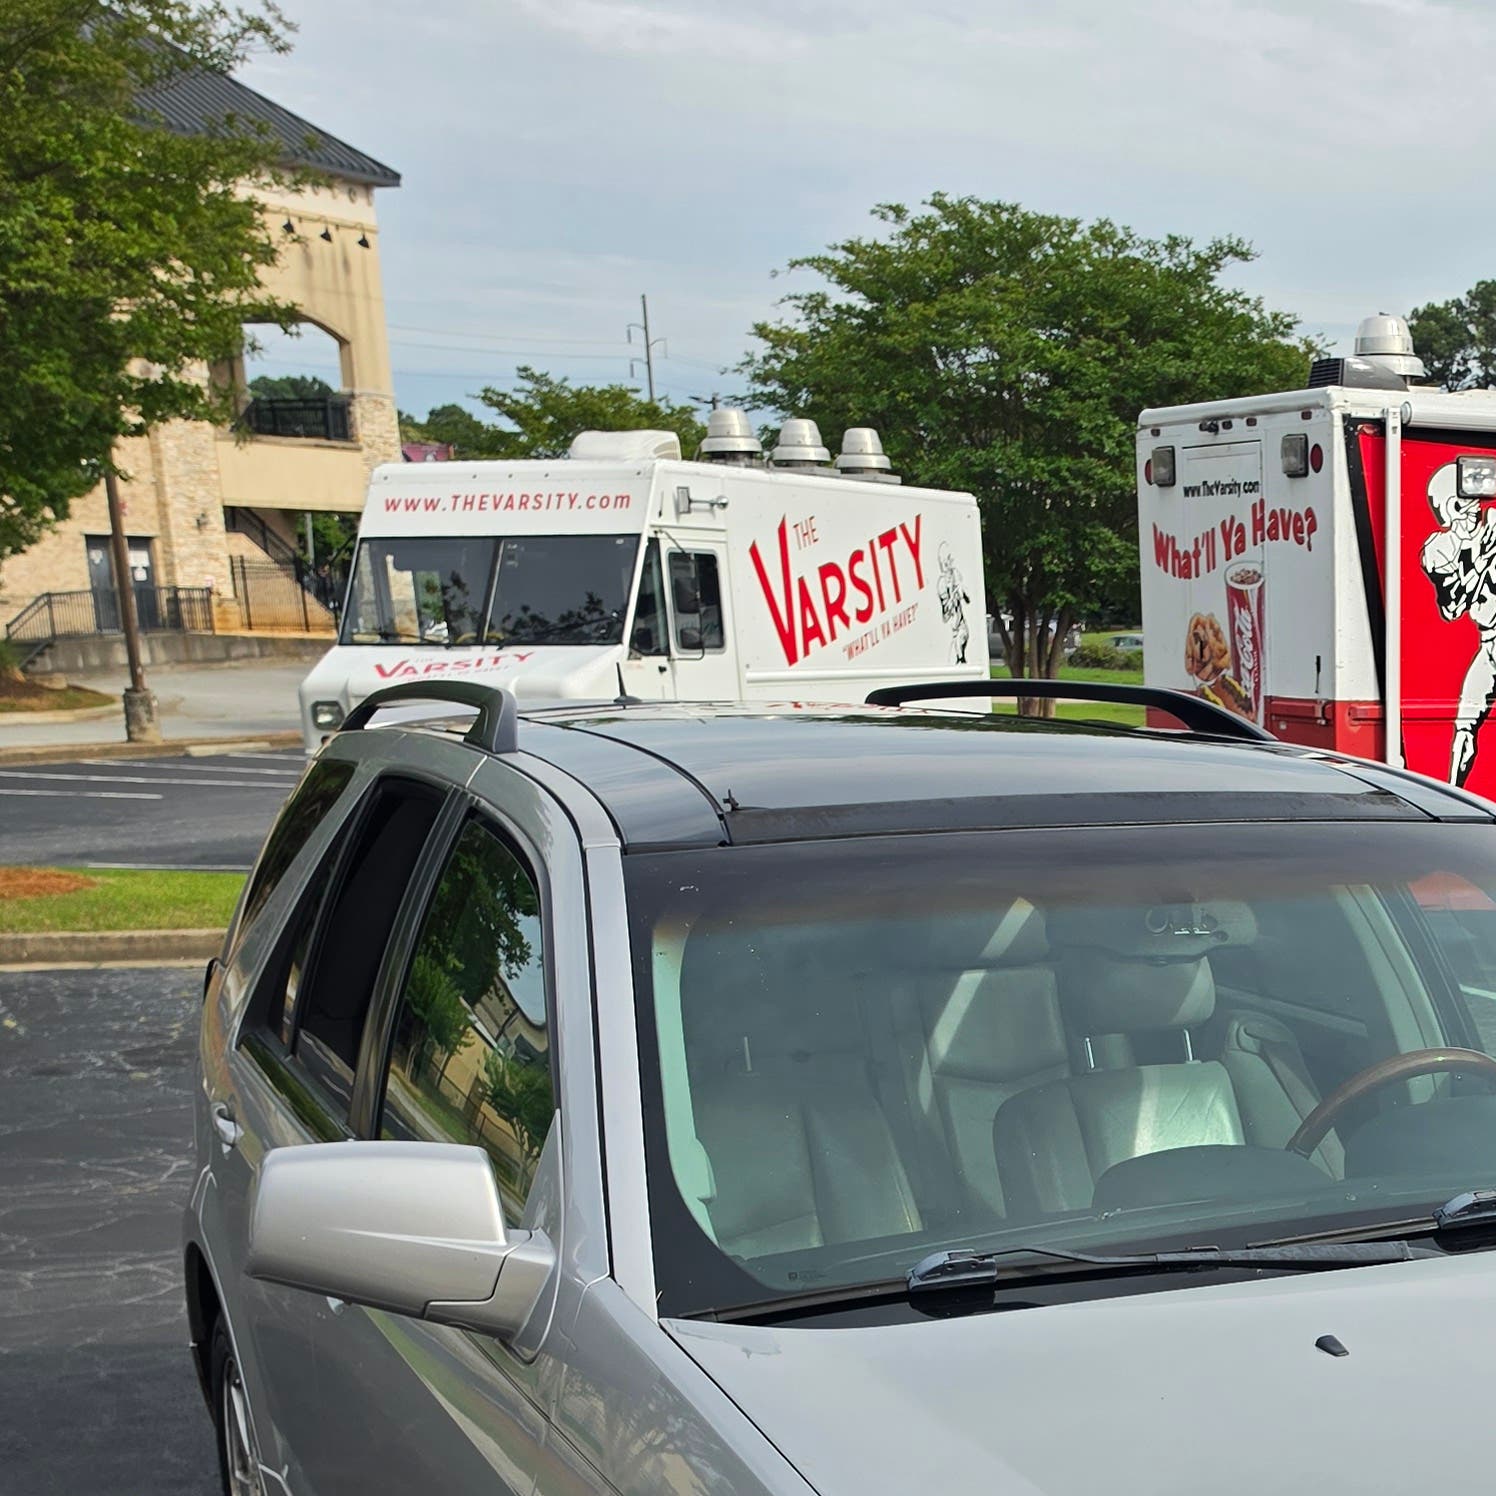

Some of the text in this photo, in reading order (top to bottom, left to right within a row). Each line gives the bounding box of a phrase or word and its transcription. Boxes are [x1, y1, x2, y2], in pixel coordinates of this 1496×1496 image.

[384, 492, 632, 513] www.THEVARSITY.com
[793, 515, 819, 550] THE
[1152, 497, 1318, 580] What'll Ya Have?
[748, 513, 926, 667] VARSITY
[373, 651, 536, 679] VARSITY
